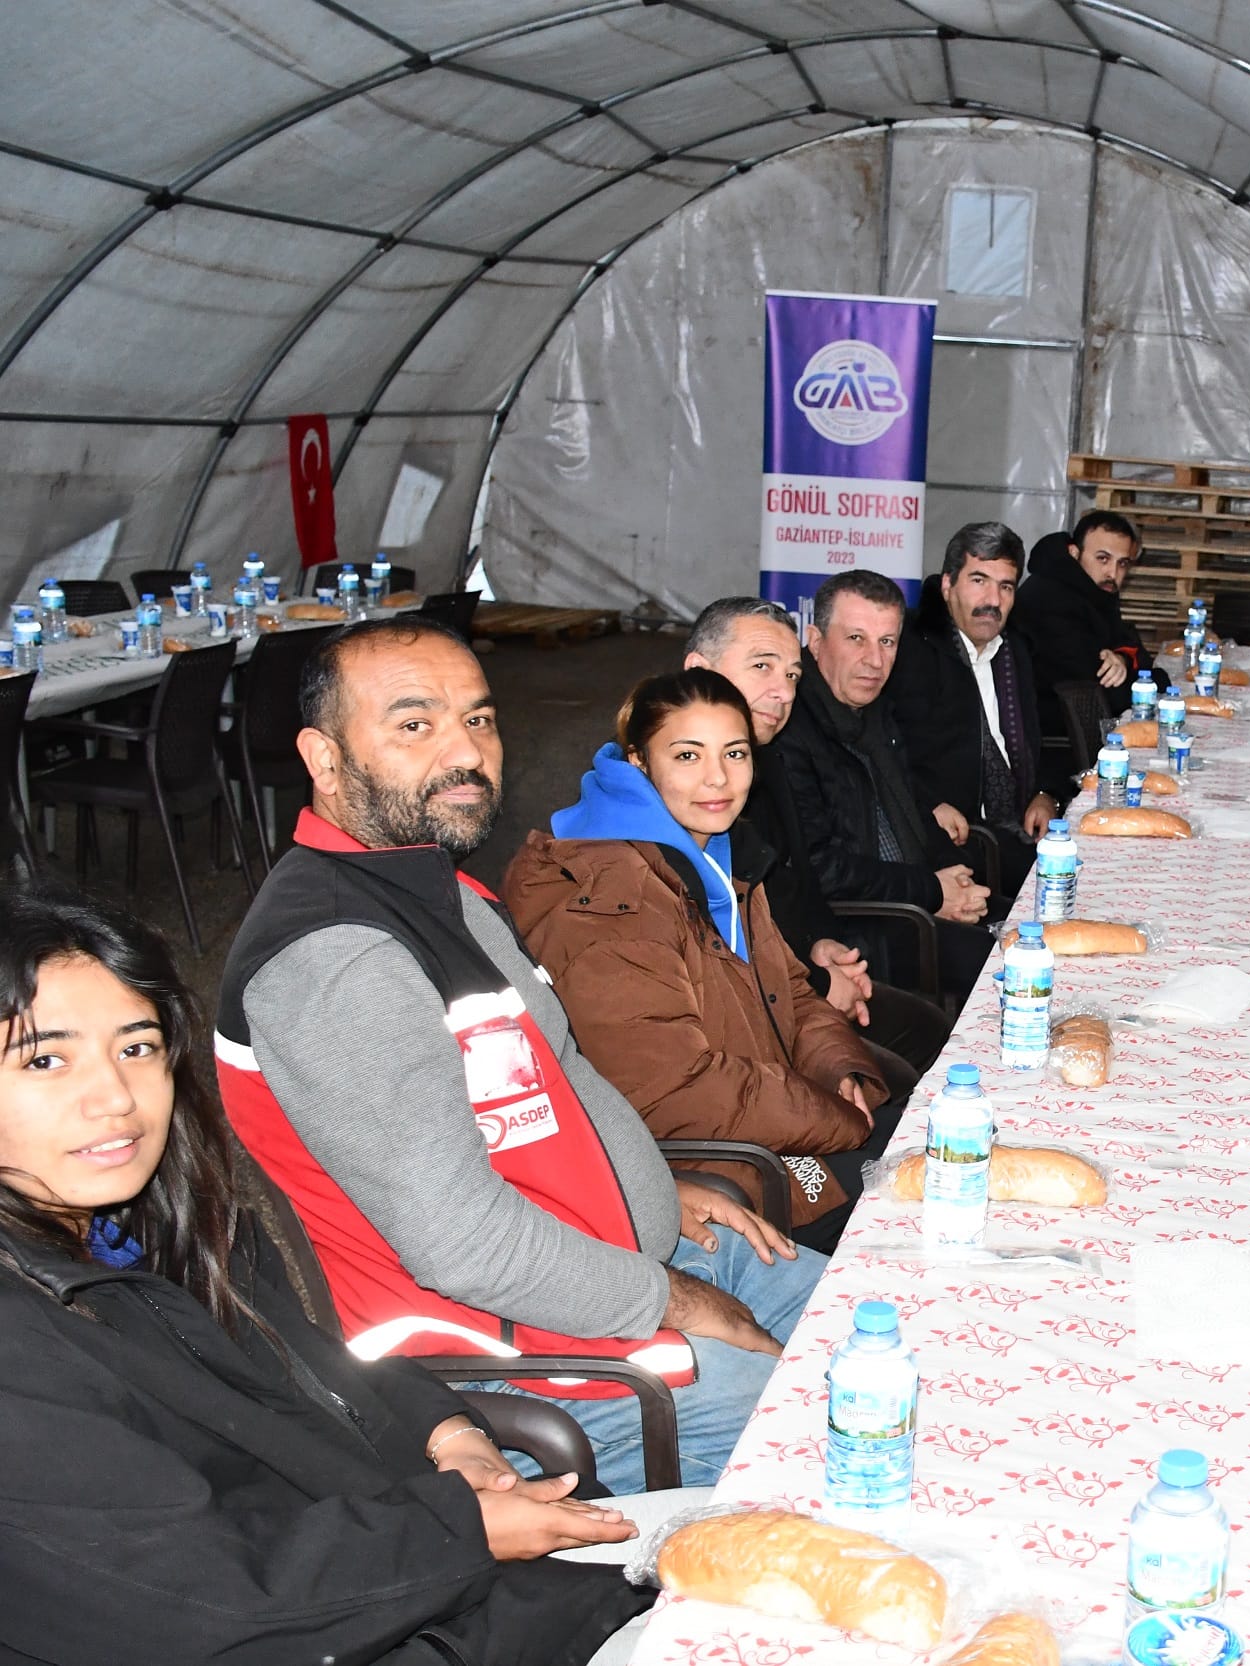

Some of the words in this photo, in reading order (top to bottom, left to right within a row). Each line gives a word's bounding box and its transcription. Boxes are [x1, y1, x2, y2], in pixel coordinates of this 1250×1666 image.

[767, 483, 831, 516] GÖNÜL
[838, 492, 919, 521] SOFRASI
[776, 524, 904, 549] GAZİANTEP-İSLAHİYE
[827, 551, 855, 565] 2023
[508, 1104, 550, 1131] ASDEP
